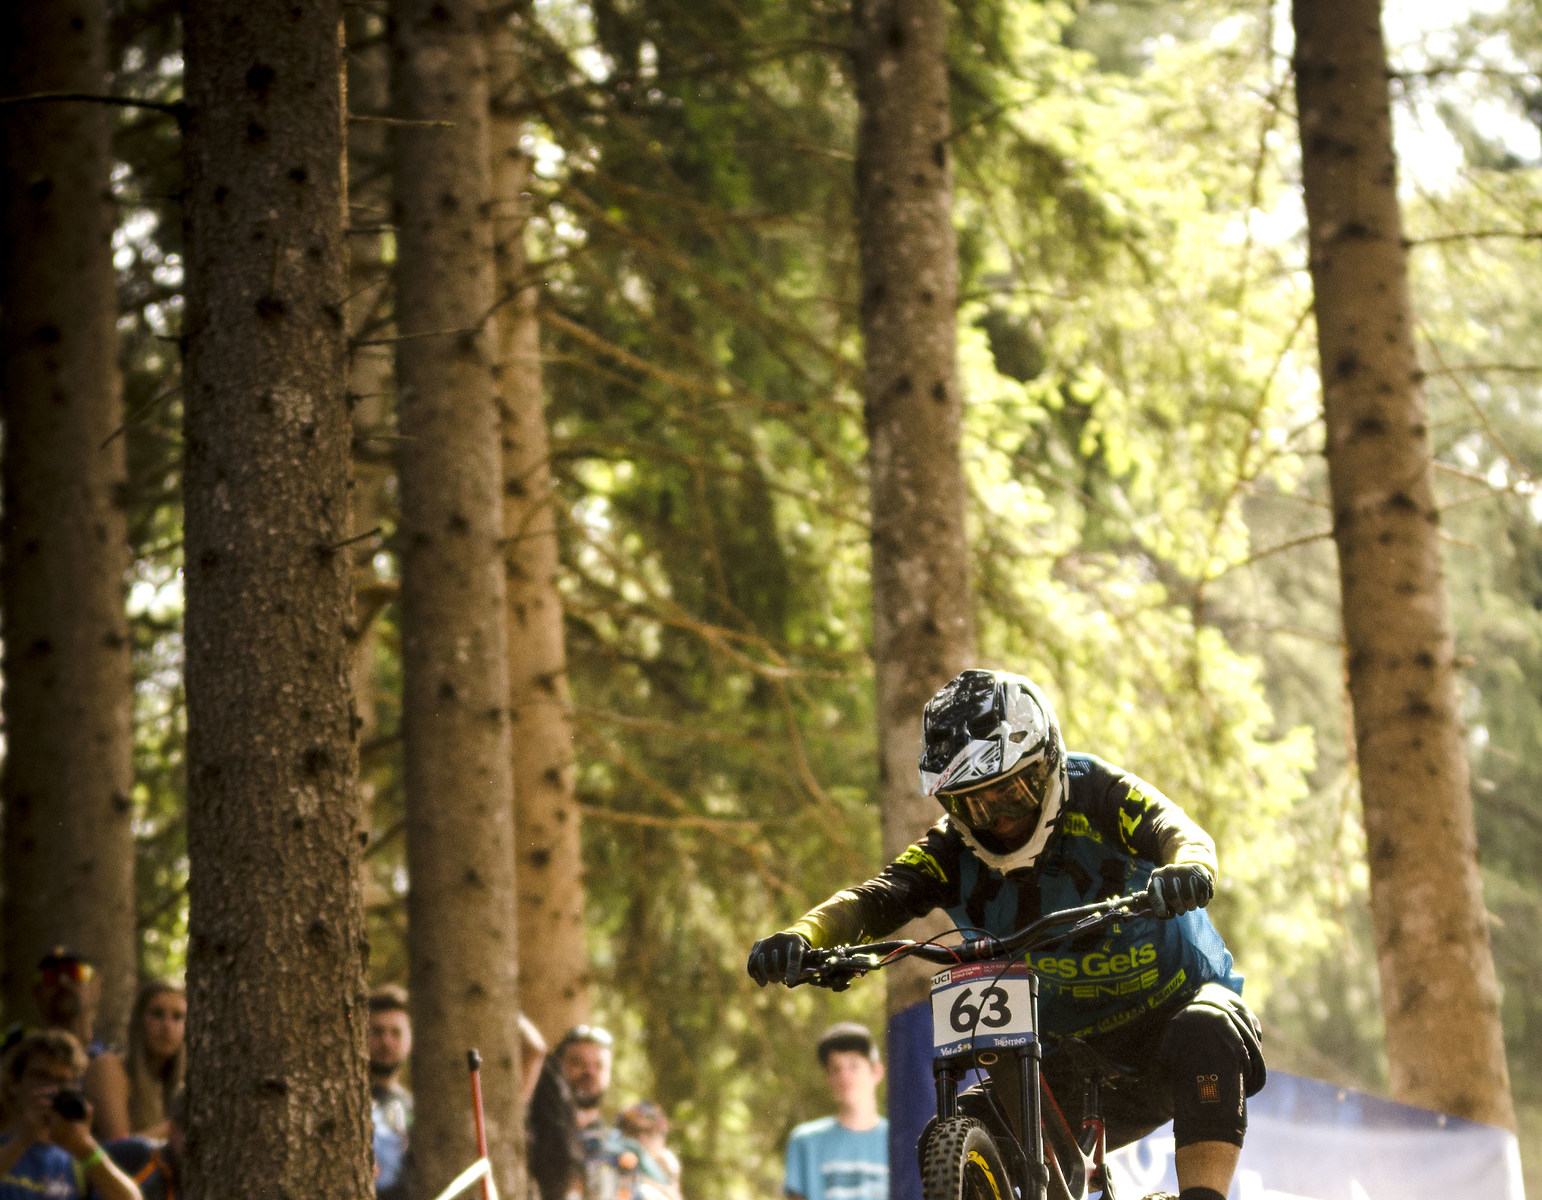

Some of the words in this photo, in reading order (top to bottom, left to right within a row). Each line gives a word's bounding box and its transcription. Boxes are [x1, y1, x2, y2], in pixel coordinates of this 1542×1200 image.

[1024, 951, 1078, 978] Les
[1082, 943, 1157, 977] Gets
[934, 973, 950, 985] UCI
[950, 987, 1012, 1033] 63
[993, 1037, 1027, 1047] TRENTINO
